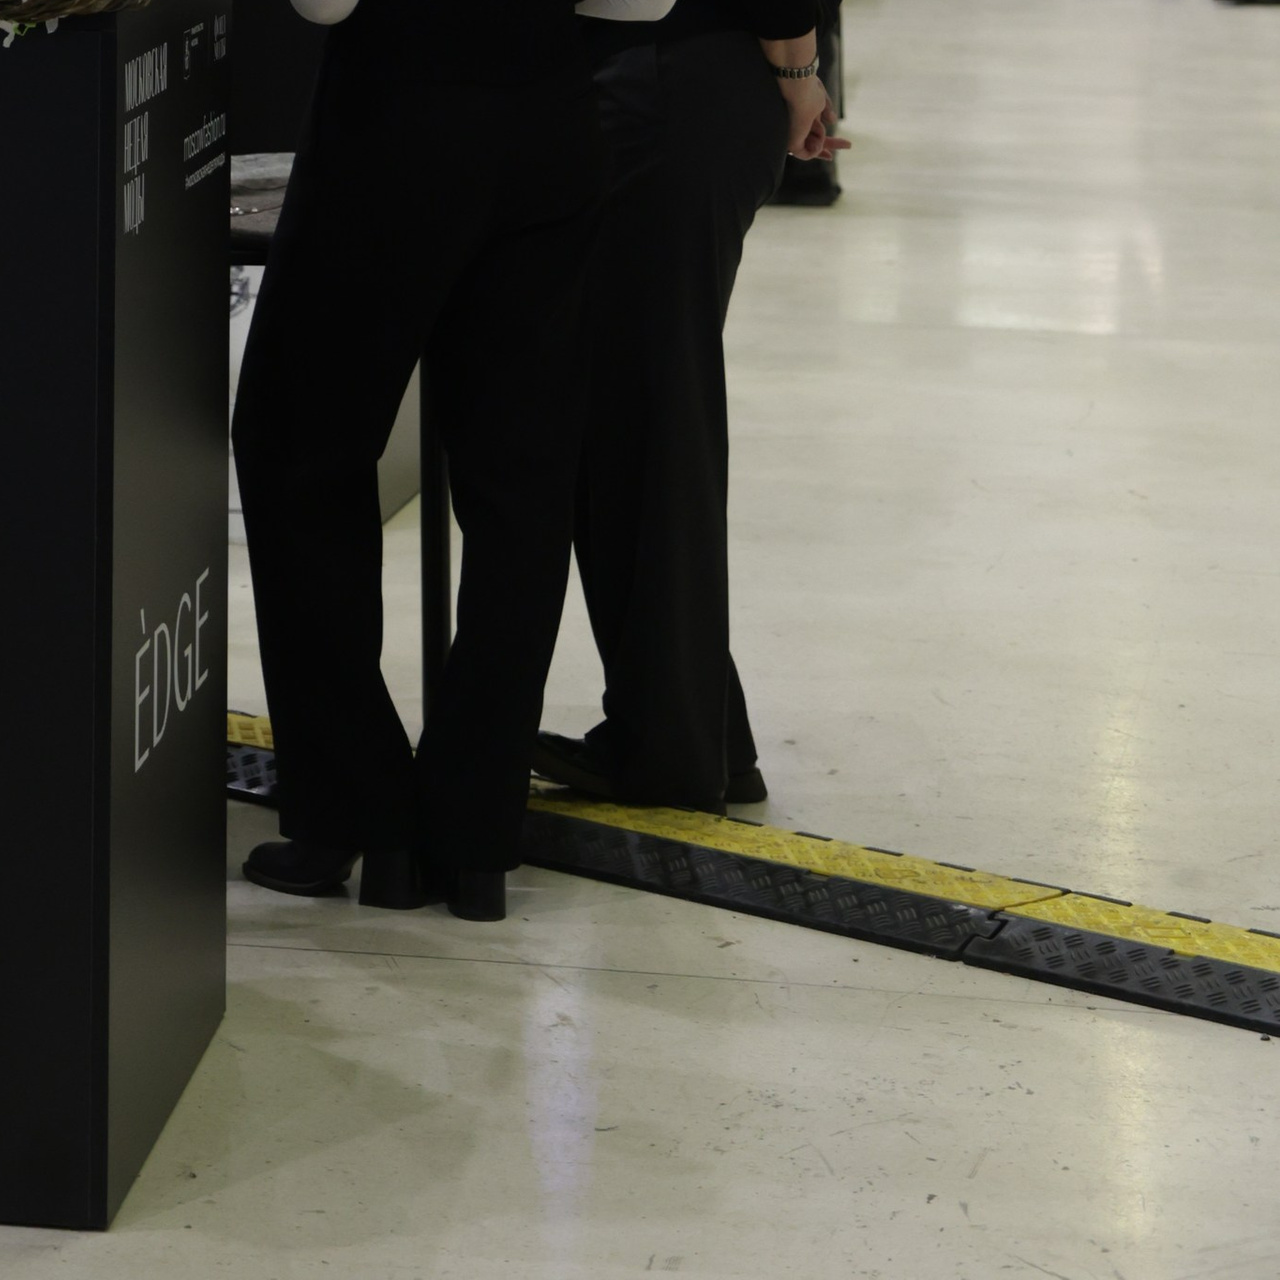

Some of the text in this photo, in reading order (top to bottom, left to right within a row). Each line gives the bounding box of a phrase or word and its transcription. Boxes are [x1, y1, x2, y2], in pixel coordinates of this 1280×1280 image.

[124, 42, 168, 112] МОСКОВСКАЯ
[123, 111, 149, 175] НЕДЕЛЯ
[123, 172, 145, 235] МОДЫ
